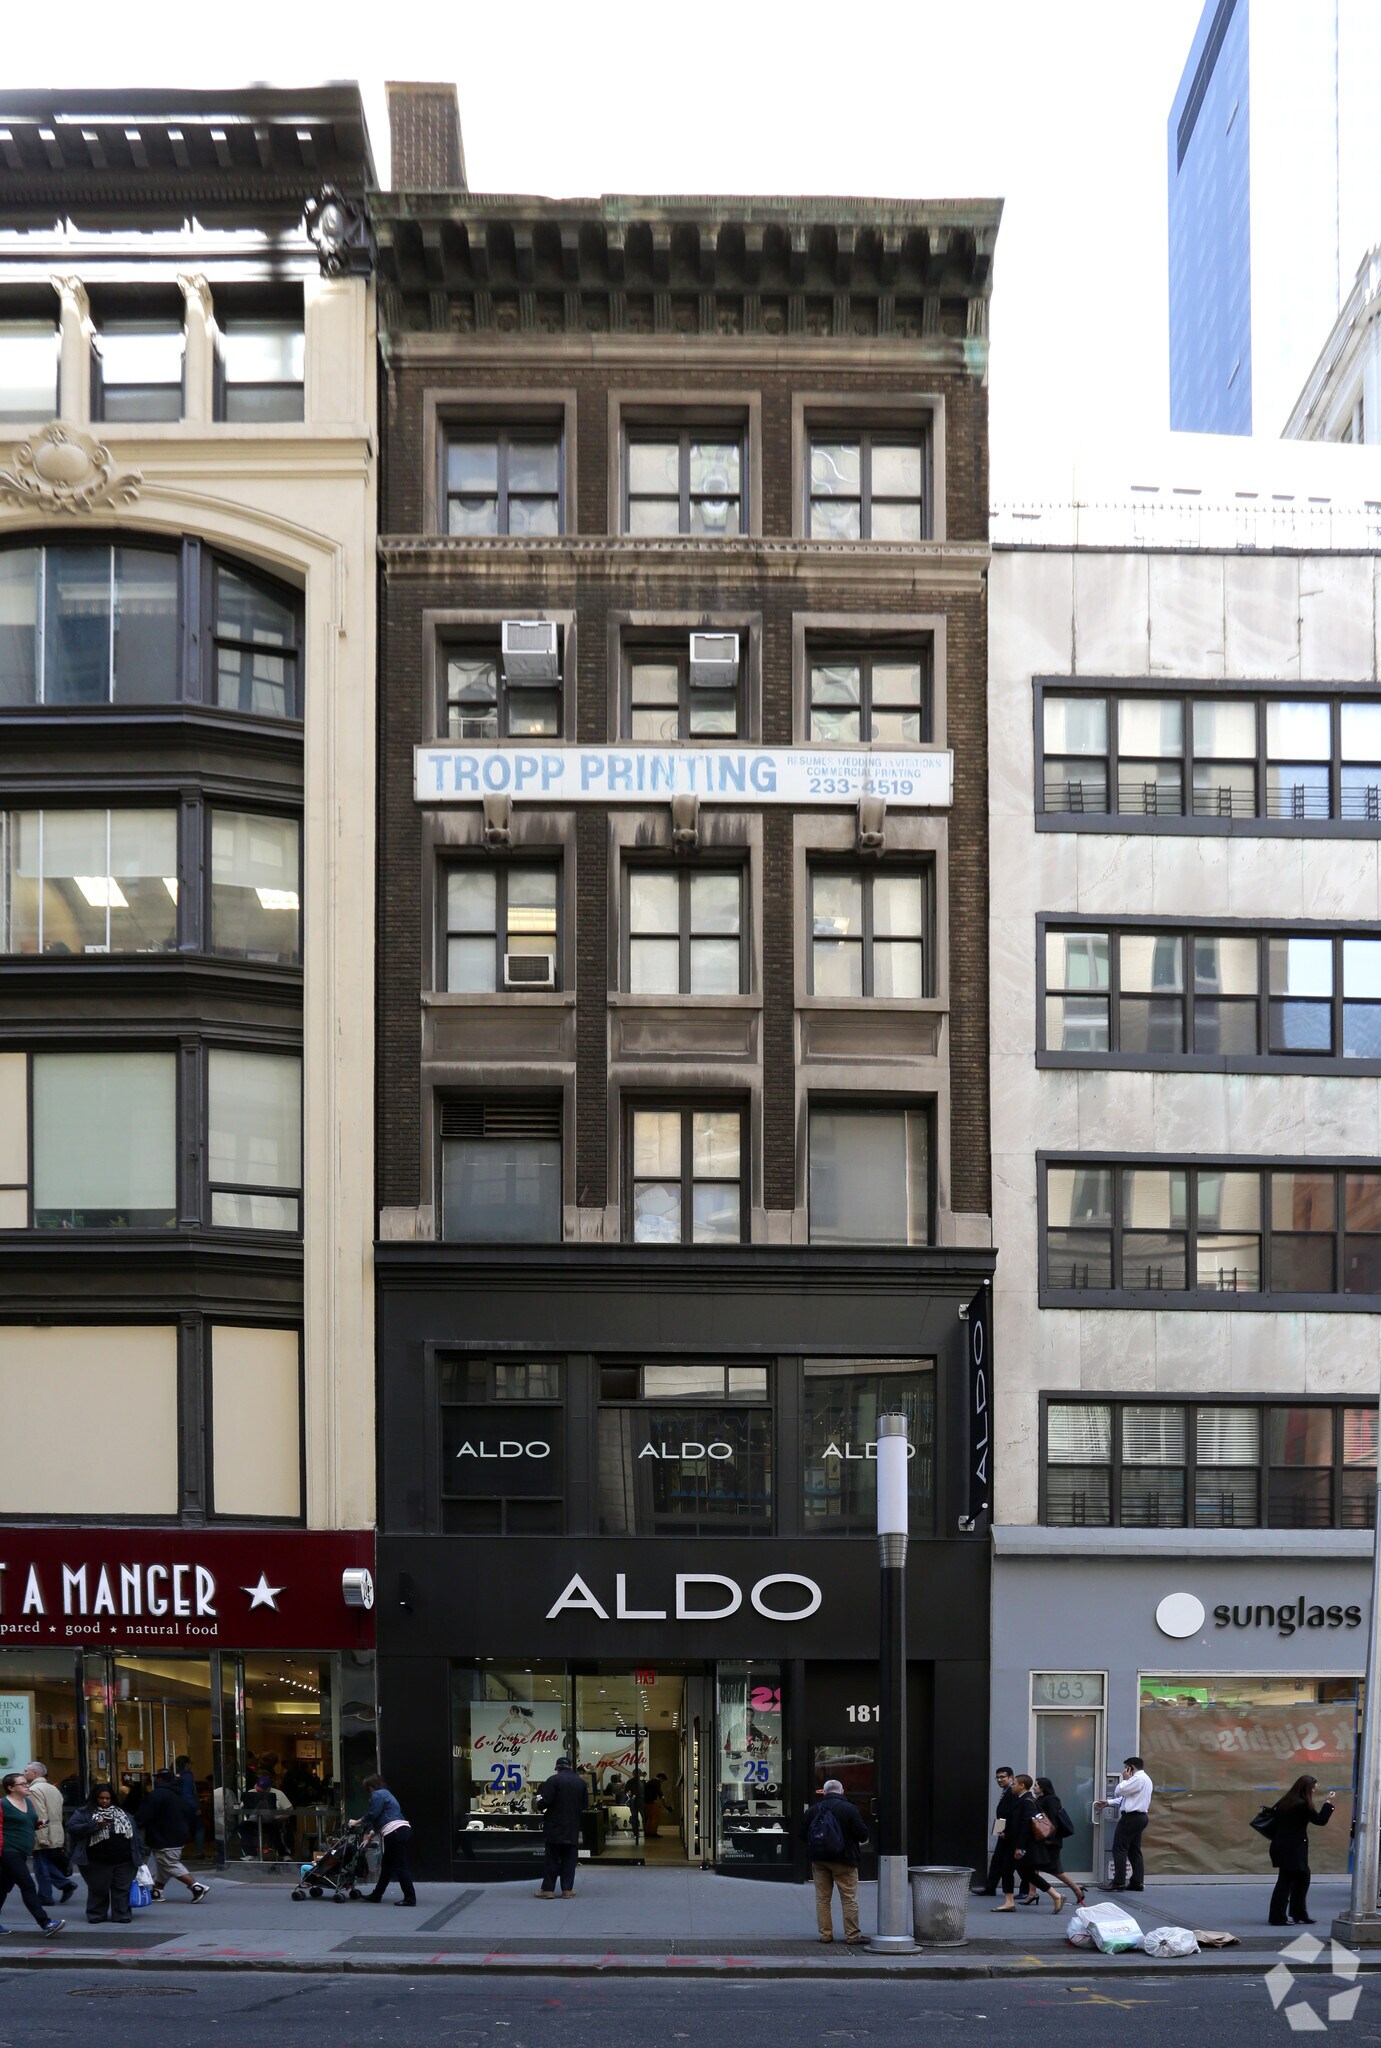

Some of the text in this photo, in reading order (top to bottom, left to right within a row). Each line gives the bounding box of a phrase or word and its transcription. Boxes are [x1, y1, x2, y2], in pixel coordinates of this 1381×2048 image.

[428, 755, 777, 792] TROPP PRINTING
[807, 767, 921, 778] COMMERCIAL PRINTING
[809, 778, 914, 795] 233-4519
[973, 1320, 989, 1484] ALDO
[456, 1441, 551, 1458] ALDO
[638, 1442, 733, 1459] ALDO
[22, 1564, 46, 1615] A
[62, 1563, 217, 1616] MANGER
[545, 1572, 823, 1621] ALDO
[1213, 1596, 1362, 1636] sunglass
[0, 1621, 218, 1636] pared good natural food
[1049, 1681, 1084, 1699] 183
[846, 1705, 880, 1722] 181
[530, 1729, 559, 1744] Aldo
[493, 1742, 522, 1756] Only
